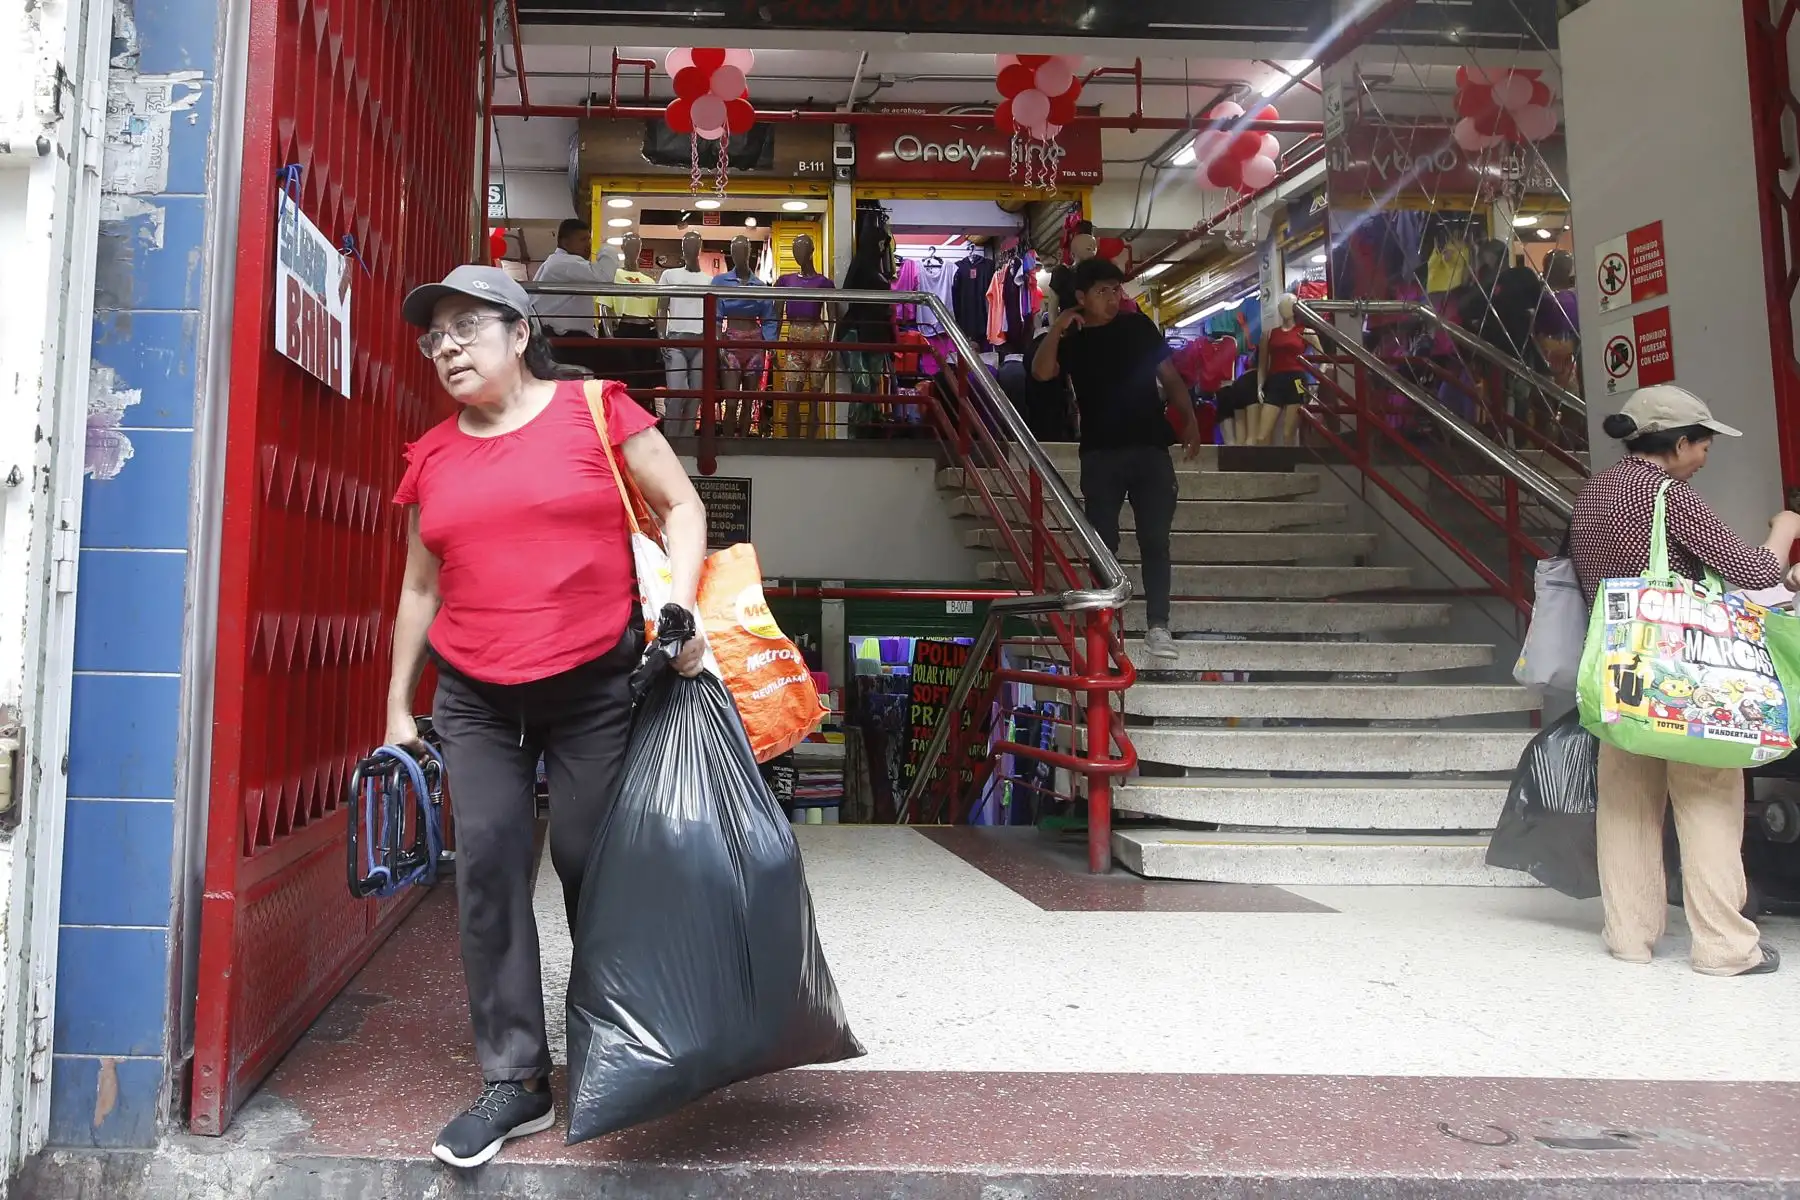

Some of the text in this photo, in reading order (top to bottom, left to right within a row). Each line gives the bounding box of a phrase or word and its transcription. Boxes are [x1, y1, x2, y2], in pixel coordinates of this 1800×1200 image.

[799, 161, 825, 172] B-111
[488, 185, 501, 203] S
[1633, 240, 1658, 255] PROHIBIDO
[1633, 249, 1660, 266] LA ENTRADA
[1635, 258, 1664, 275] VENDEDORES
[1633, 269, 1663, 285] AMBULANTES
[1639, 328, 1667, 343] PROHIBIDO
[1641, 340, 1666, 354] INGRESAR
[1640, 351, 1670, 367] CON CASCO
[700, 482, 741, 491] COMERCIAL
[701, 491, 747, 501] DE GAMARRA
[951, 601, 968, 613] B-007
[1684, 627, 1775, 678] MARCAS
[912, 664, 938, 685] POLAR
[1656, 720, 1685, 731] TOTTUS
